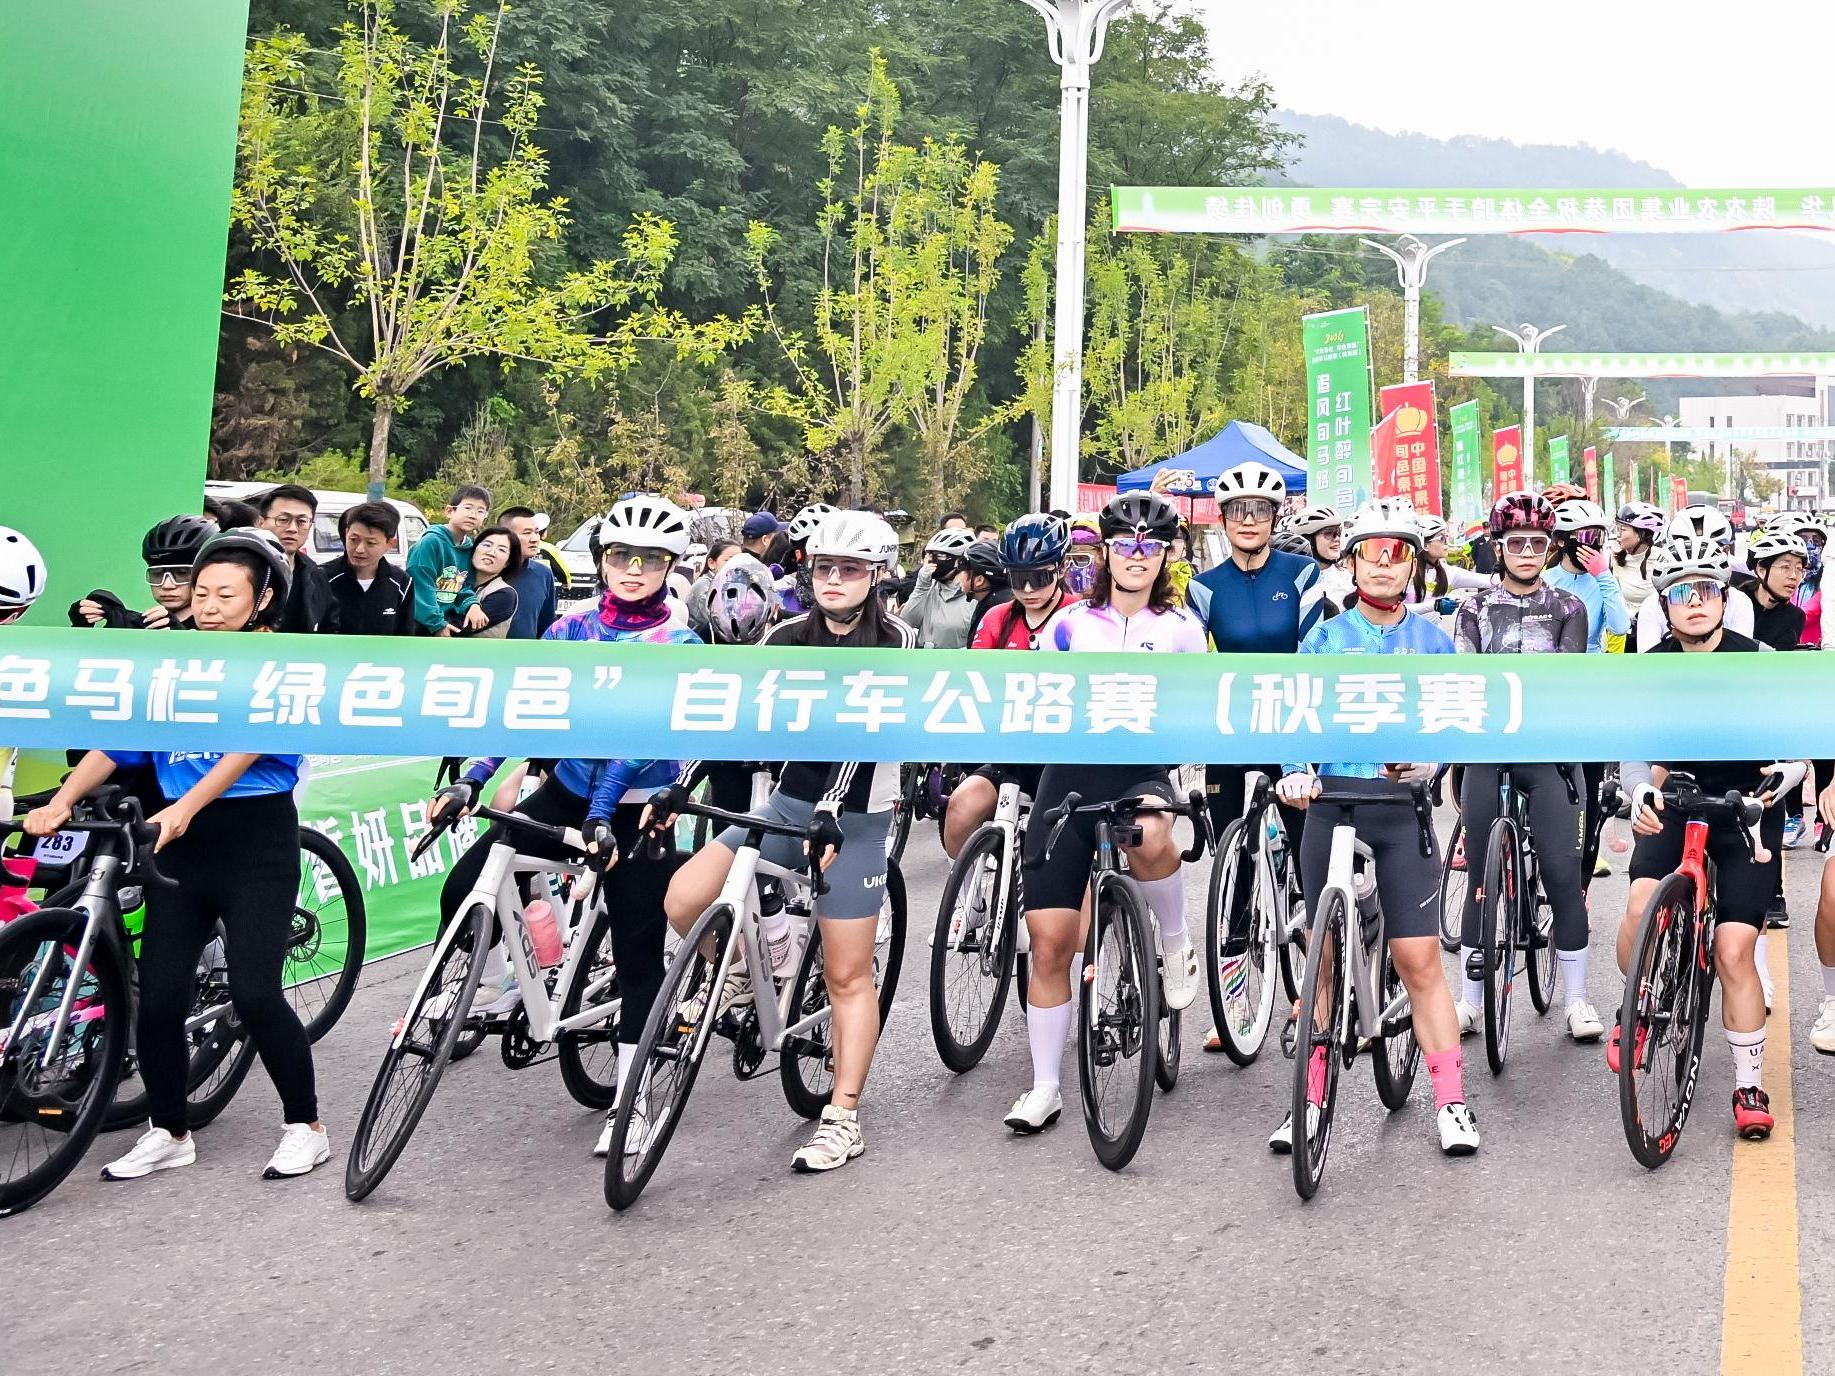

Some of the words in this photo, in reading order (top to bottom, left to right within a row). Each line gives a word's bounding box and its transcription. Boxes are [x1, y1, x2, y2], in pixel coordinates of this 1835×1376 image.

[249, 660, 621, 730] 绿色旬邑”
[669, 669, 1159, 735] 自行车公路赛
[1216, 672, 1525, 735] （秋季赛）
[40, 835, 74, 852] 283
